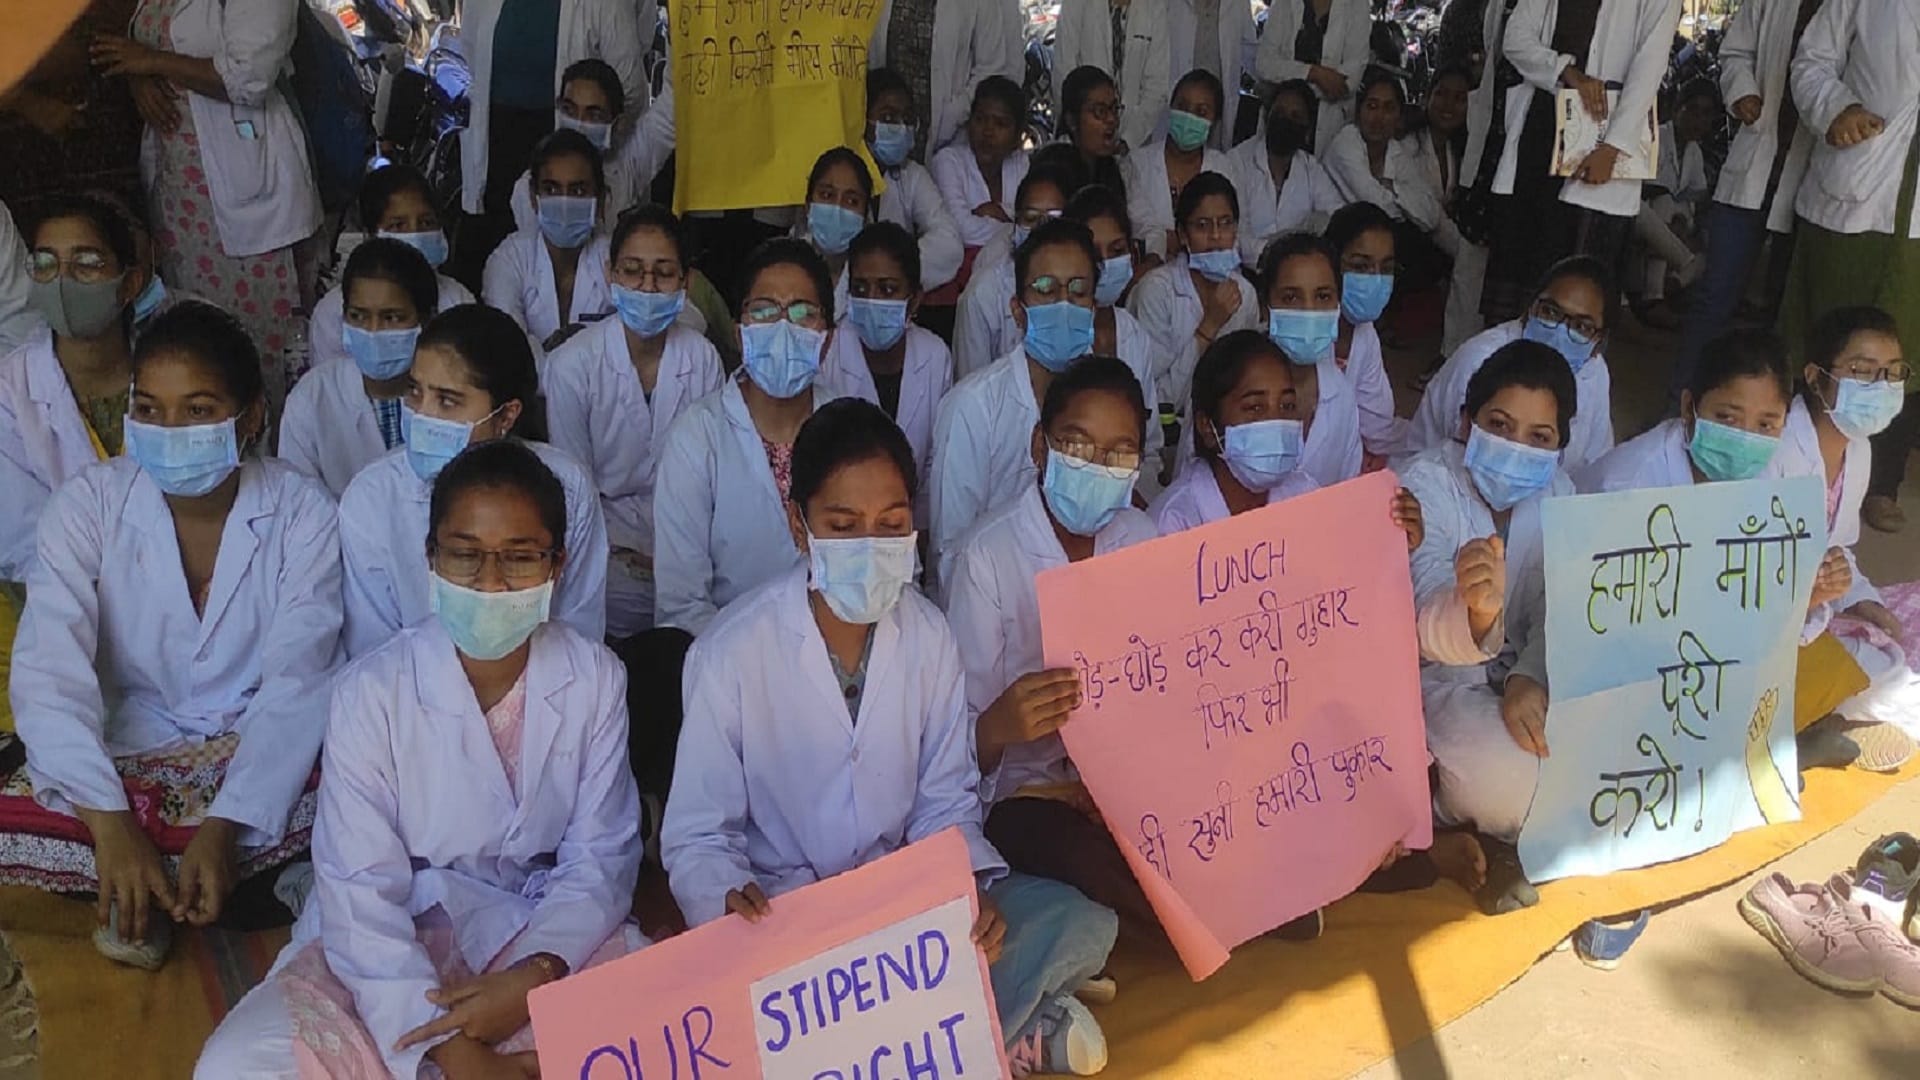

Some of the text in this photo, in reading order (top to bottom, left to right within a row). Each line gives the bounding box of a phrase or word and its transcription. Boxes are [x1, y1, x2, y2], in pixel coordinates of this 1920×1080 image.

[1196, 539, 1286, 606] LUNCH
[1587, 503, 1692, 634] हमारी
[1181, 622, 1231, 677] कर
[1235, 590, 1287, 658] करी
[1292, 587, 1360, 647] गुहार
[1194, 658, 1296, 750] फिर भी
[1657, 630, 1740, 740] पूरी
[1250, 741, 1322, 827] हमारी
[1324, 735, 1393, 801] पुकार
[760, 930, 950, 1052] STIPEND
